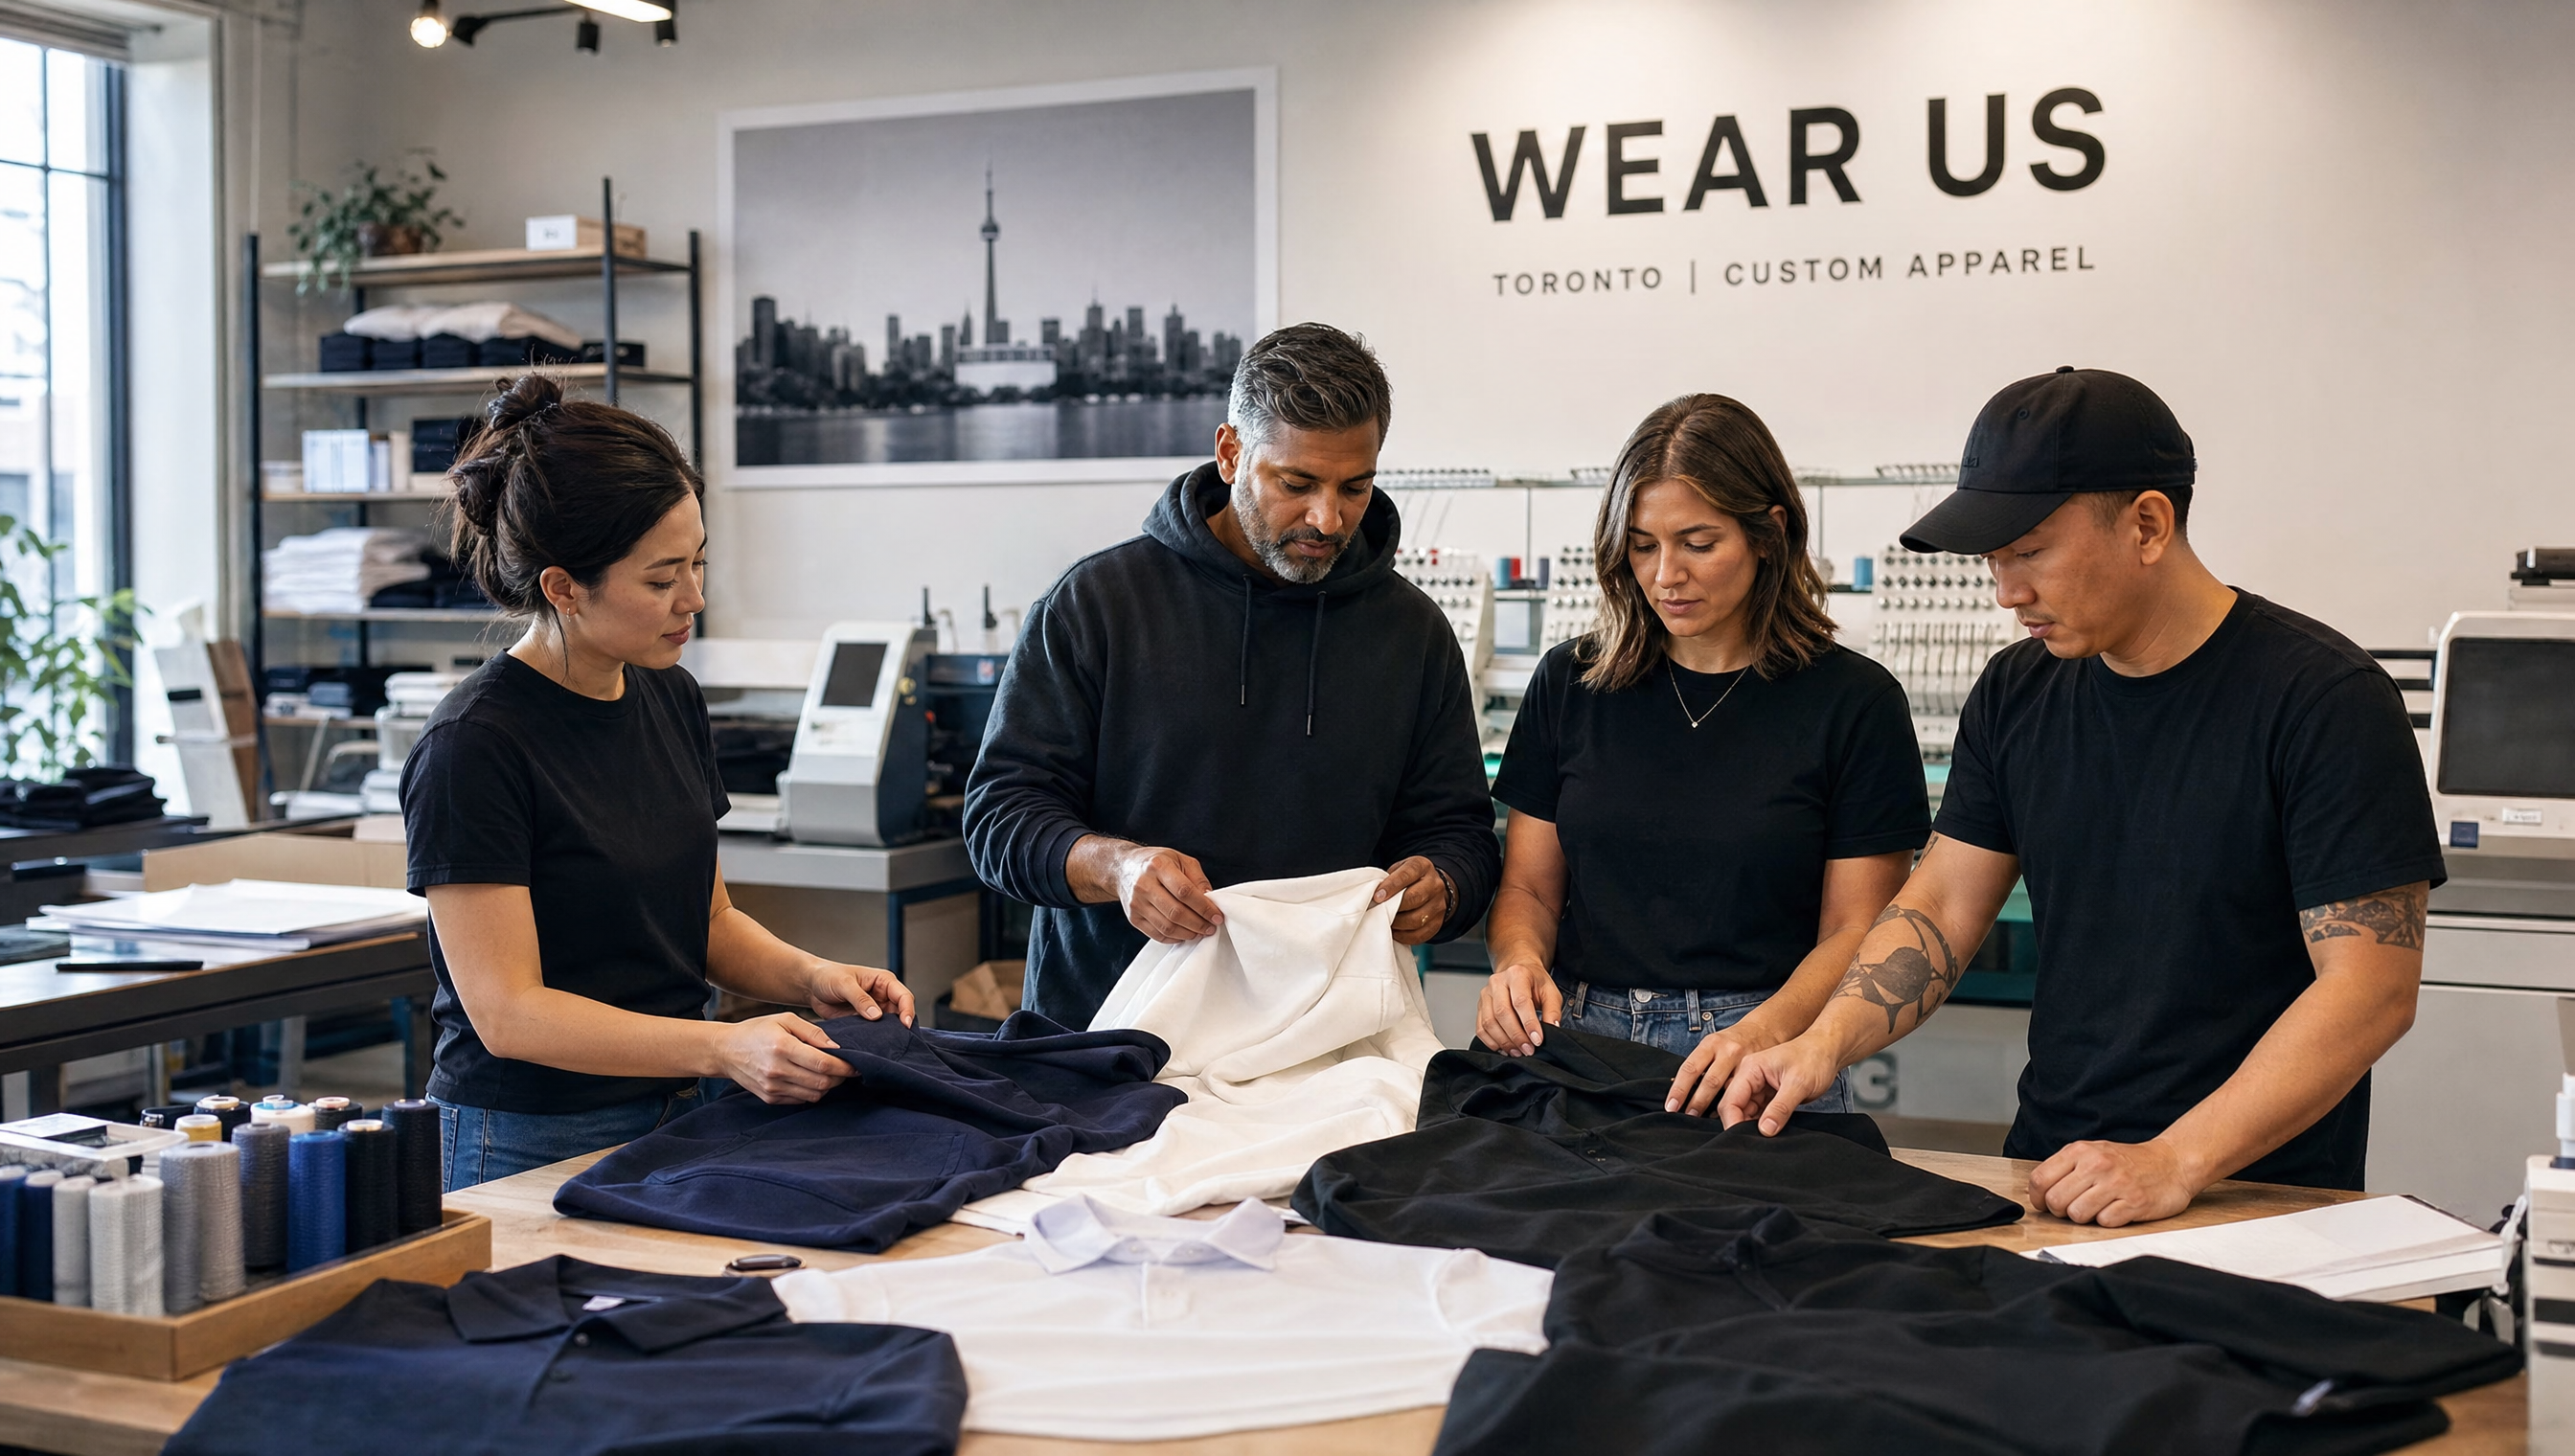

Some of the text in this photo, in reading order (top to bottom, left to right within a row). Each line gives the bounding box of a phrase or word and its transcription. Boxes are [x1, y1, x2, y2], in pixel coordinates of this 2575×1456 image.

[1470, 87, 2107, 222] WEAR US
[1493, 266, 1663, 296] TORONTO
[1724, 255, 1883, 286] CUSTOM
[1907, 245, 2096, 279] APPAREL
